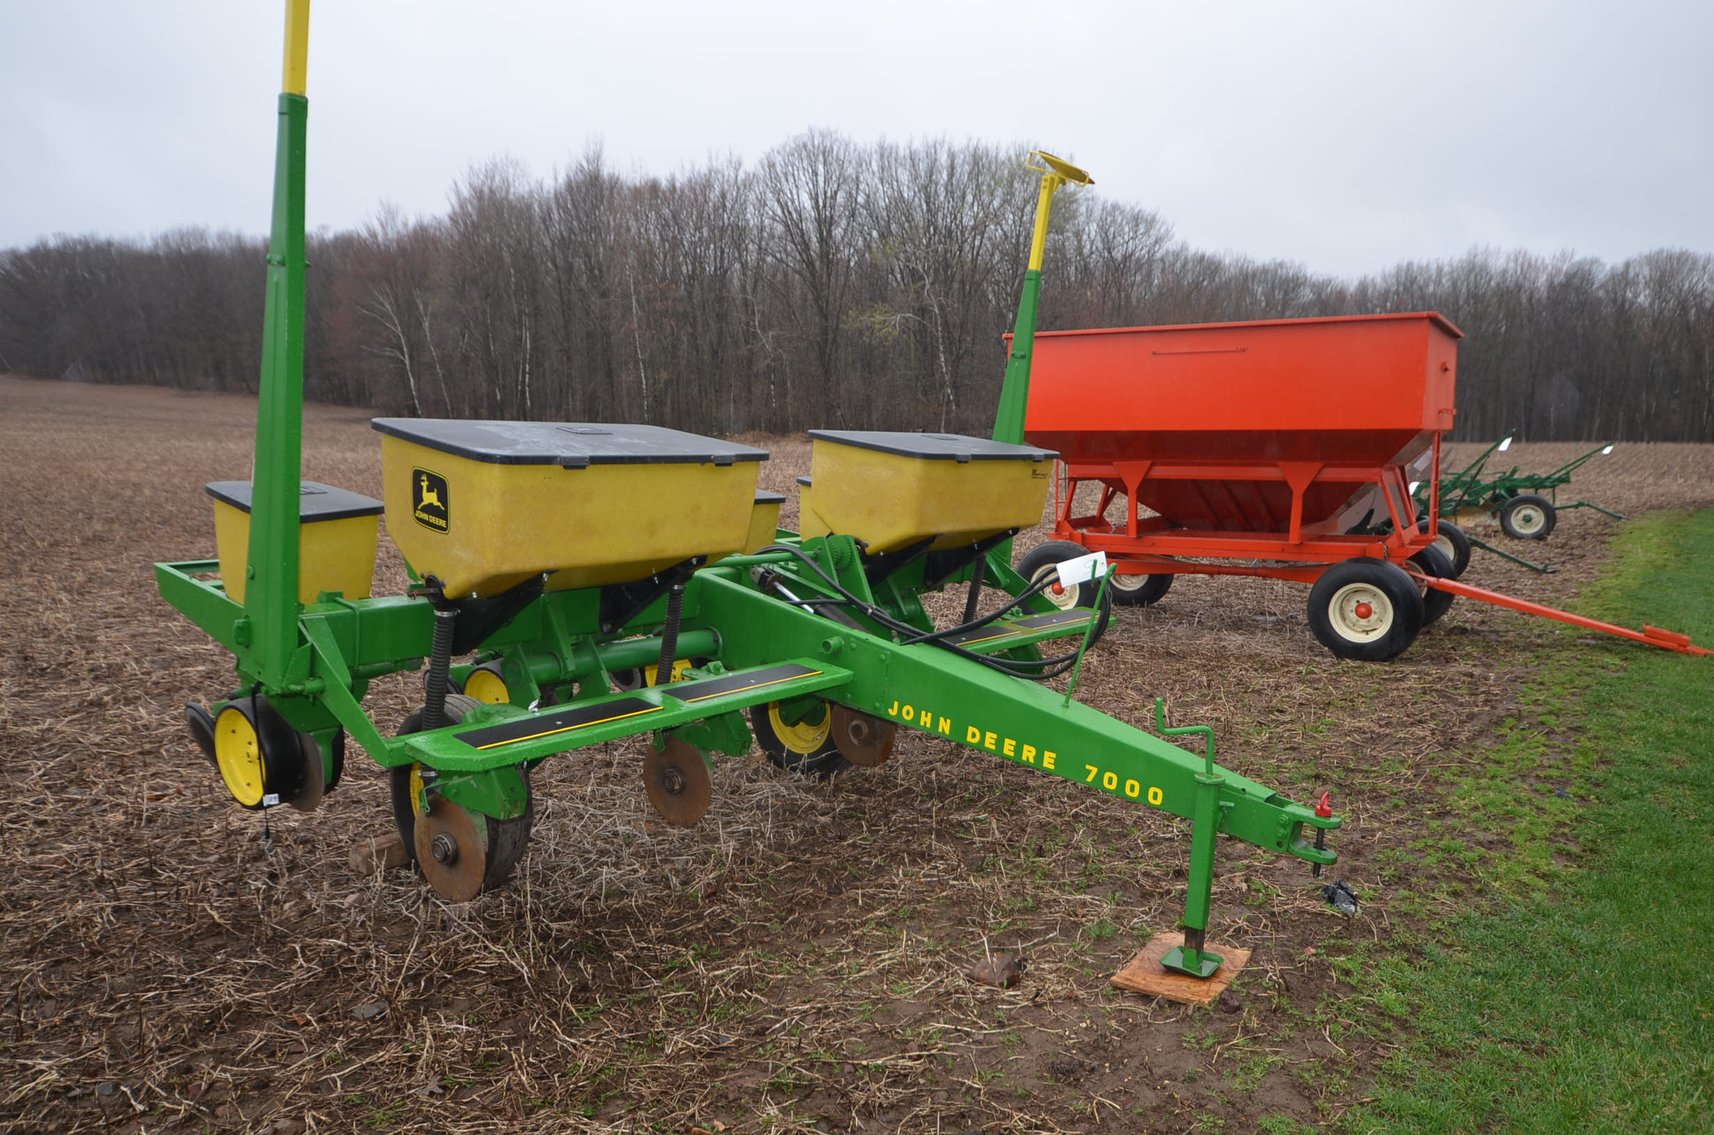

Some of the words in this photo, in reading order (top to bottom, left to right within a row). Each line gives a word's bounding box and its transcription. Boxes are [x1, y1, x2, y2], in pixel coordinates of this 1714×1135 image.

[415, 510, 428, 520] JOHN
[429, 515, 447, 528] DEERE
[888, 700, 951, 735] JOHN
[966, 725, 1057, 770] DEERE
[1085, 764, 1163, 806] 7000
